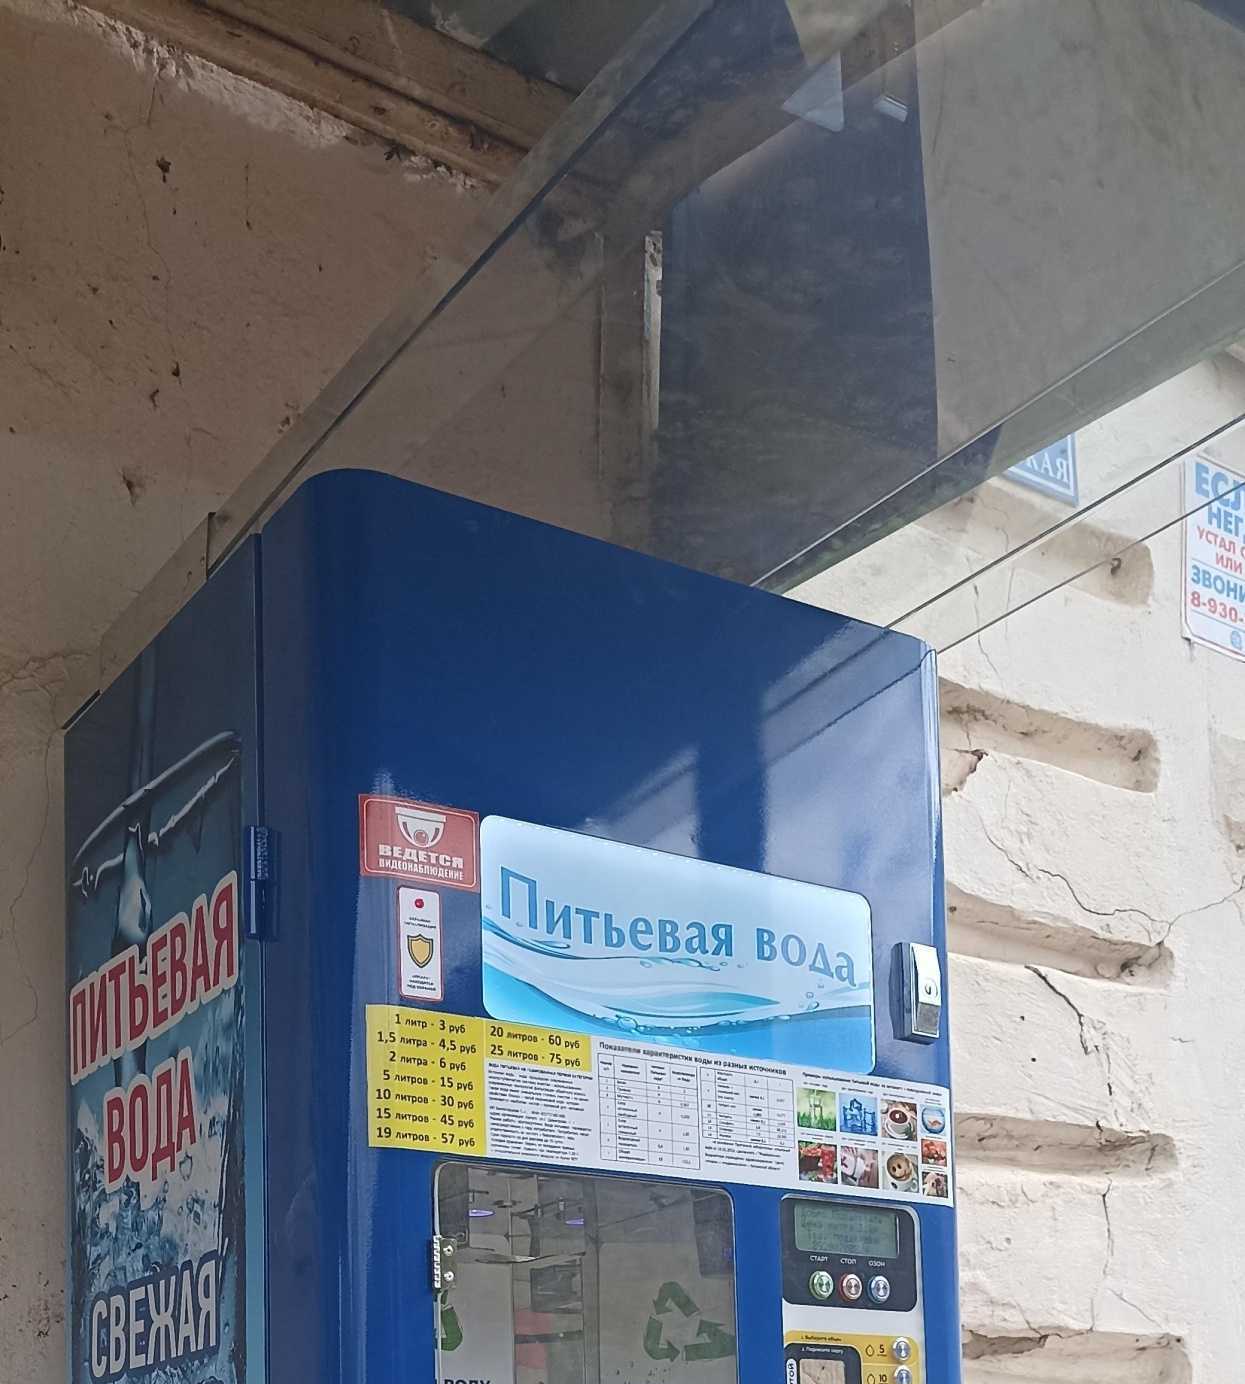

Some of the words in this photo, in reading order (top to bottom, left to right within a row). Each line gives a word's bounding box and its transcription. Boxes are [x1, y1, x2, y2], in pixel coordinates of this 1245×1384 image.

[1197, 526, 1235, 555] УСТАЛ
[1216, 553, 1242, 574] ИЛИ
[379, 844, 463, 868] ВЕДЕТСЯ
[379, 858, 464, 880] ВИДЕОНАБЛЮДЕНИЕ
[500, 865, 733, 957] Питьевая
[756, 927, 857, 987] вода
[72, 882, 235, 1076] ПИТЬЕВАЯ
[395, 1014, 401, 1024] 1
[405, 1018, 427, 1029] литр
[439, 1020, 446, 1030] 3
[449, 1025, 466, 1034] руб
[377, 1031, 396, 1043] 1,5
[400, 1036, 427, 1047] литра
[439, 1038, 457, 1051] 4,5
[460, 1045, 477, 1054] руб
[490, 1025, 504, 1038] 20
[507, 1031, 538, 1043] литров
[548, 1035, 561, 1046] 60
[564, 1040, 580, 1049] руб
[389, 1051, 396, 1062] 2
[400, 1056, 428, 1066] литра
[439, 1058, 446, 1068] 6
[449, 1062, 466, 1071] руб
[490, 1044, 504, 1056] 25
[507, 1050, 538, 1061] литров
[549, 1053, 562, 1064] 75
[565, 1058, 581, 1067] руб
[383, 1070, 390, 1080] 5
[394, 1074, 428, 1085] литров
[440, 1077, 453, 1088] 15
[457, 1082, 474, 1091] руб
[376, 1089, 391, 1100] 10
[395, 1093, 429, 1104] литров
[440, 1096, 454, 1107] 30
[457, 1100, 474, 1109] руб
[106, 1057, 197, 1184] ВОДА
[376, 1108, 391, 1119] 15
[395, 1112, 429, 1123] литров
[440, 1114, 454, 1126] 45
[458, 1119, 474, 1128] руб
[376, 1127, 392, 1138] 19
[396, 1131, 430, 1142] литров
[441, 1133, 455, 1144] 57
[458, 1138, 475, 1147] руб
[91, 1259, 217, 1379] СВЕЖАЯ
[879, 1344, 885, 1353] 5
[879, 1374, 888, 1382] 10
